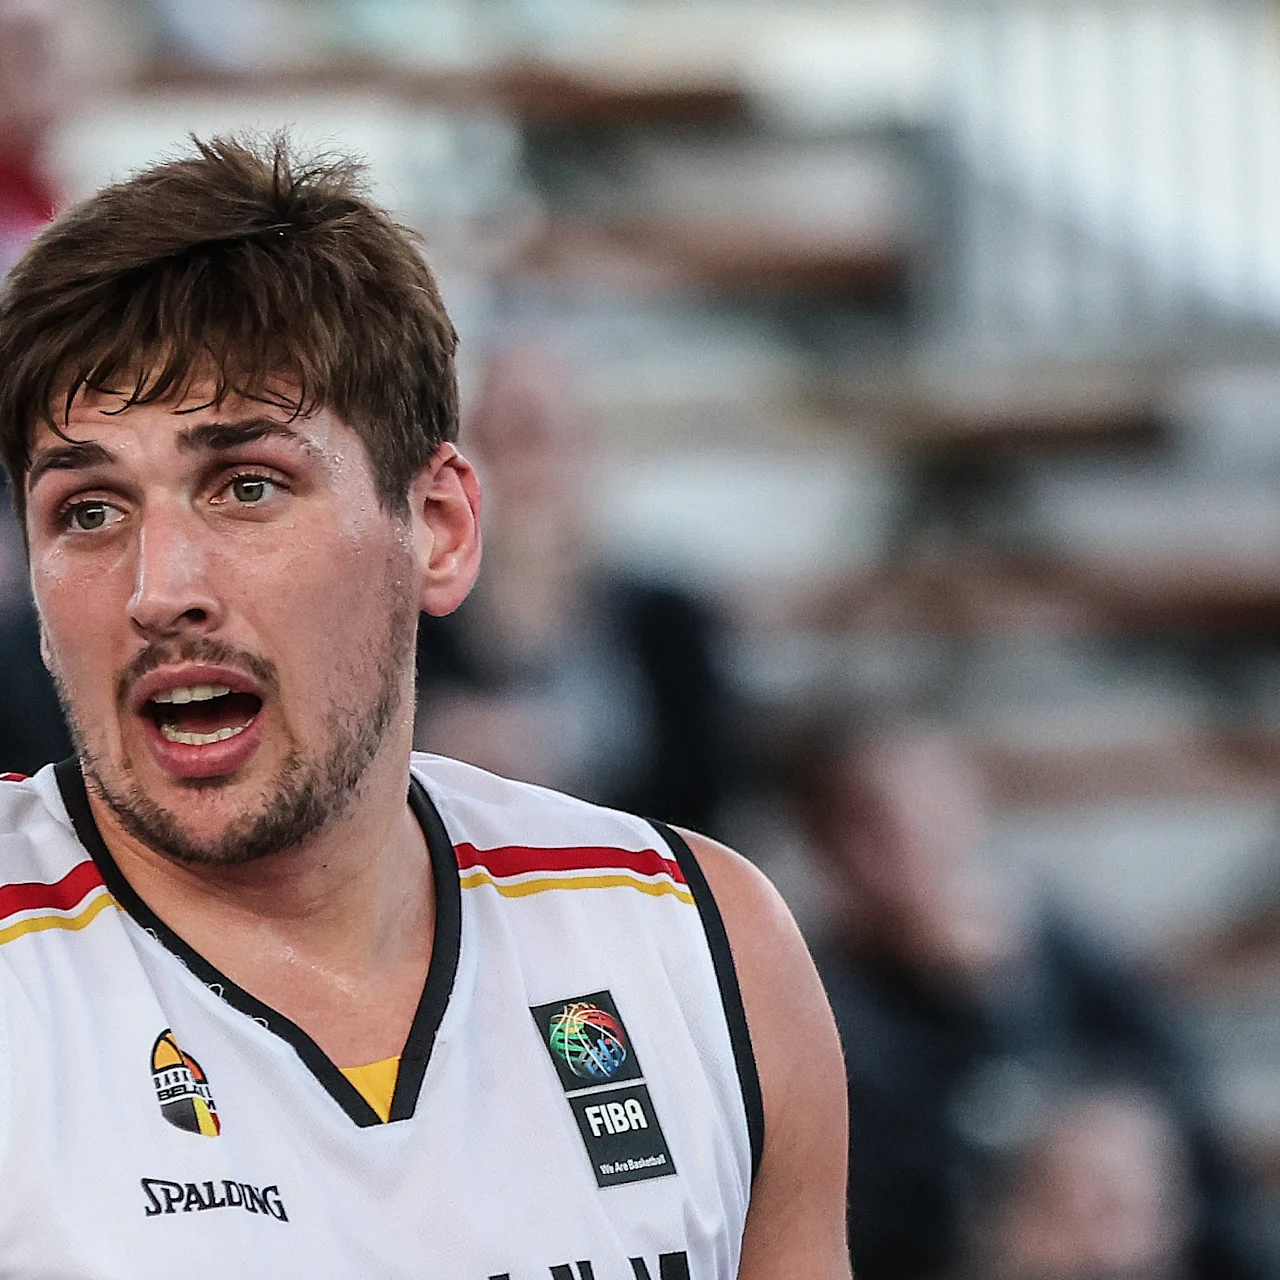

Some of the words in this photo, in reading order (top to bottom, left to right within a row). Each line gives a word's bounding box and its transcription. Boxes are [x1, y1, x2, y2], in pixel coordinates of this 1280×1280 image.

[584, 1098, 649, 1137] FIBA
[599, 1163, 615, 1175] We
[614, 1160, 629, 1173] Are
[627, 1153, 667, 1171] Basketball
[140, 1177, 290, 1223] SPALDING
